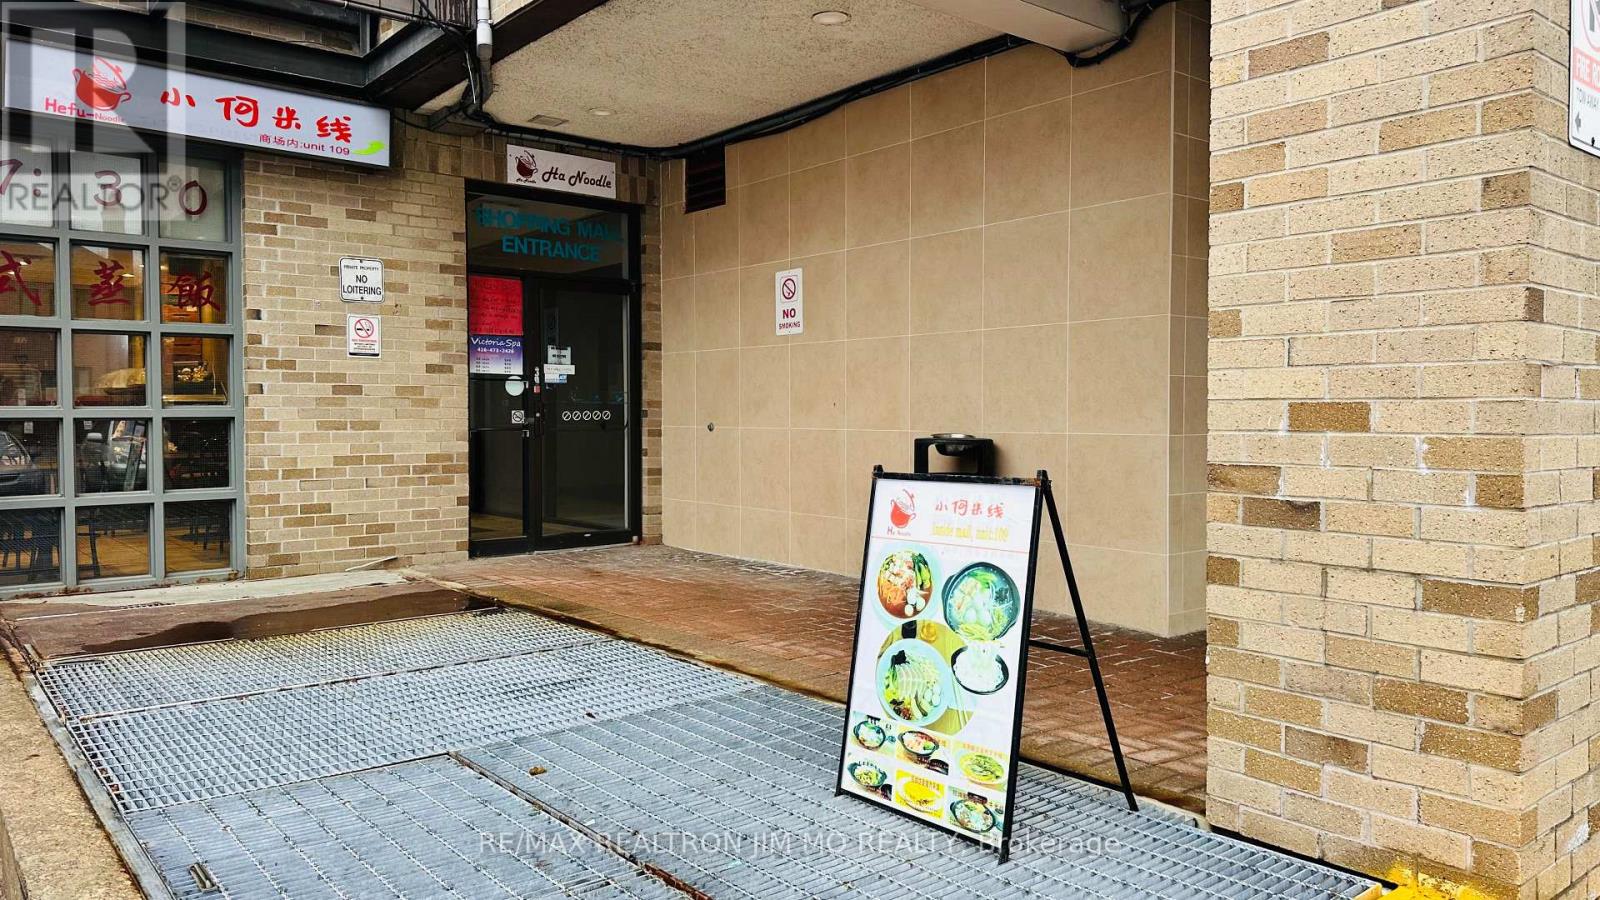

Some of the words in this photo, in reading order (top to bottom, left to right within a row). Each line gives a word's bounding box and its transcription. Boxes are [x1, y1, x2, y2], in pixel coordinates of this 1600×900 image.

[160, 86, 353, 144] 小何米线
[329, 144, 350, 156] 109
[541, 166, 565, 182] Ha
[568, 170, 612, 189] Noodle
[475, 205, 571, 236] SHOPPING
[501, 234, 602, 262] ENTRANCE
[355, 274, 368, 284] NO
[342, 284, 382, 296] LOITERING
[782, 307, 796, 320] NO
[778, 321, 801, 330] SMOKING
[470, 336, 506, 346] Victoria
[505, 339, 521, 348] Spa
[935, 499, 1004, 519] 小何米线
